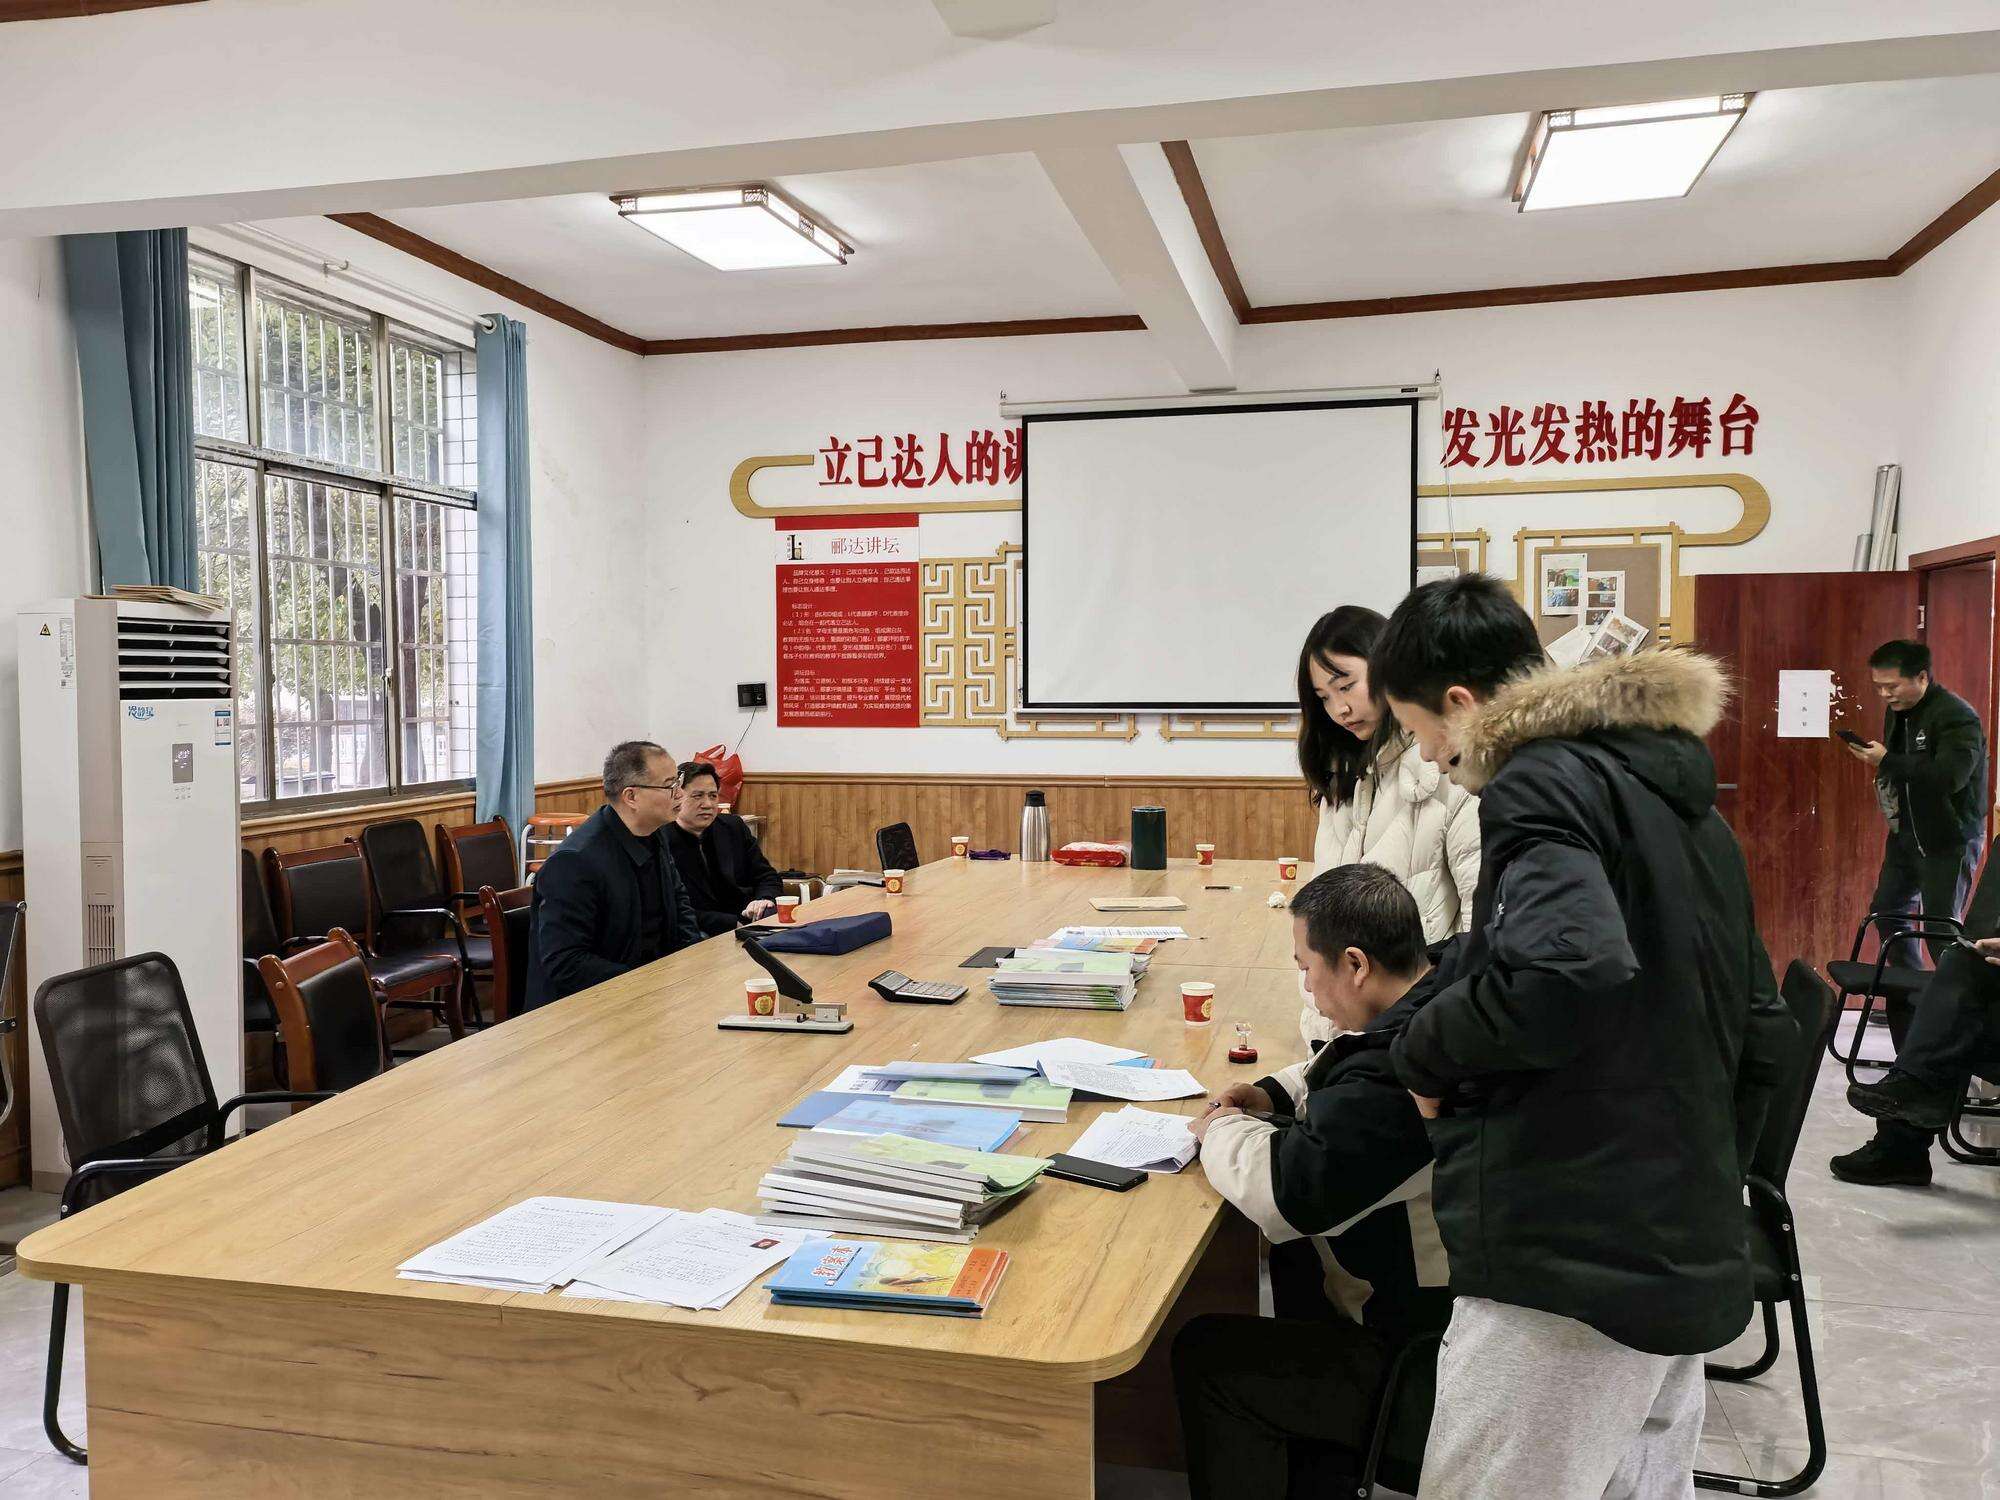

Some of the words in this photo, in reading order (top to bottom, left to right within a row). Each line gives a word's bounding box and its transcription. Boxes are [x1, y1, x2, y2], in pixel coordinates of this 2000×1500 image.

[1440, 393, 1759, 469] 发光发热的舞台
[831, 536, 900, 556] 郦达讲坛
